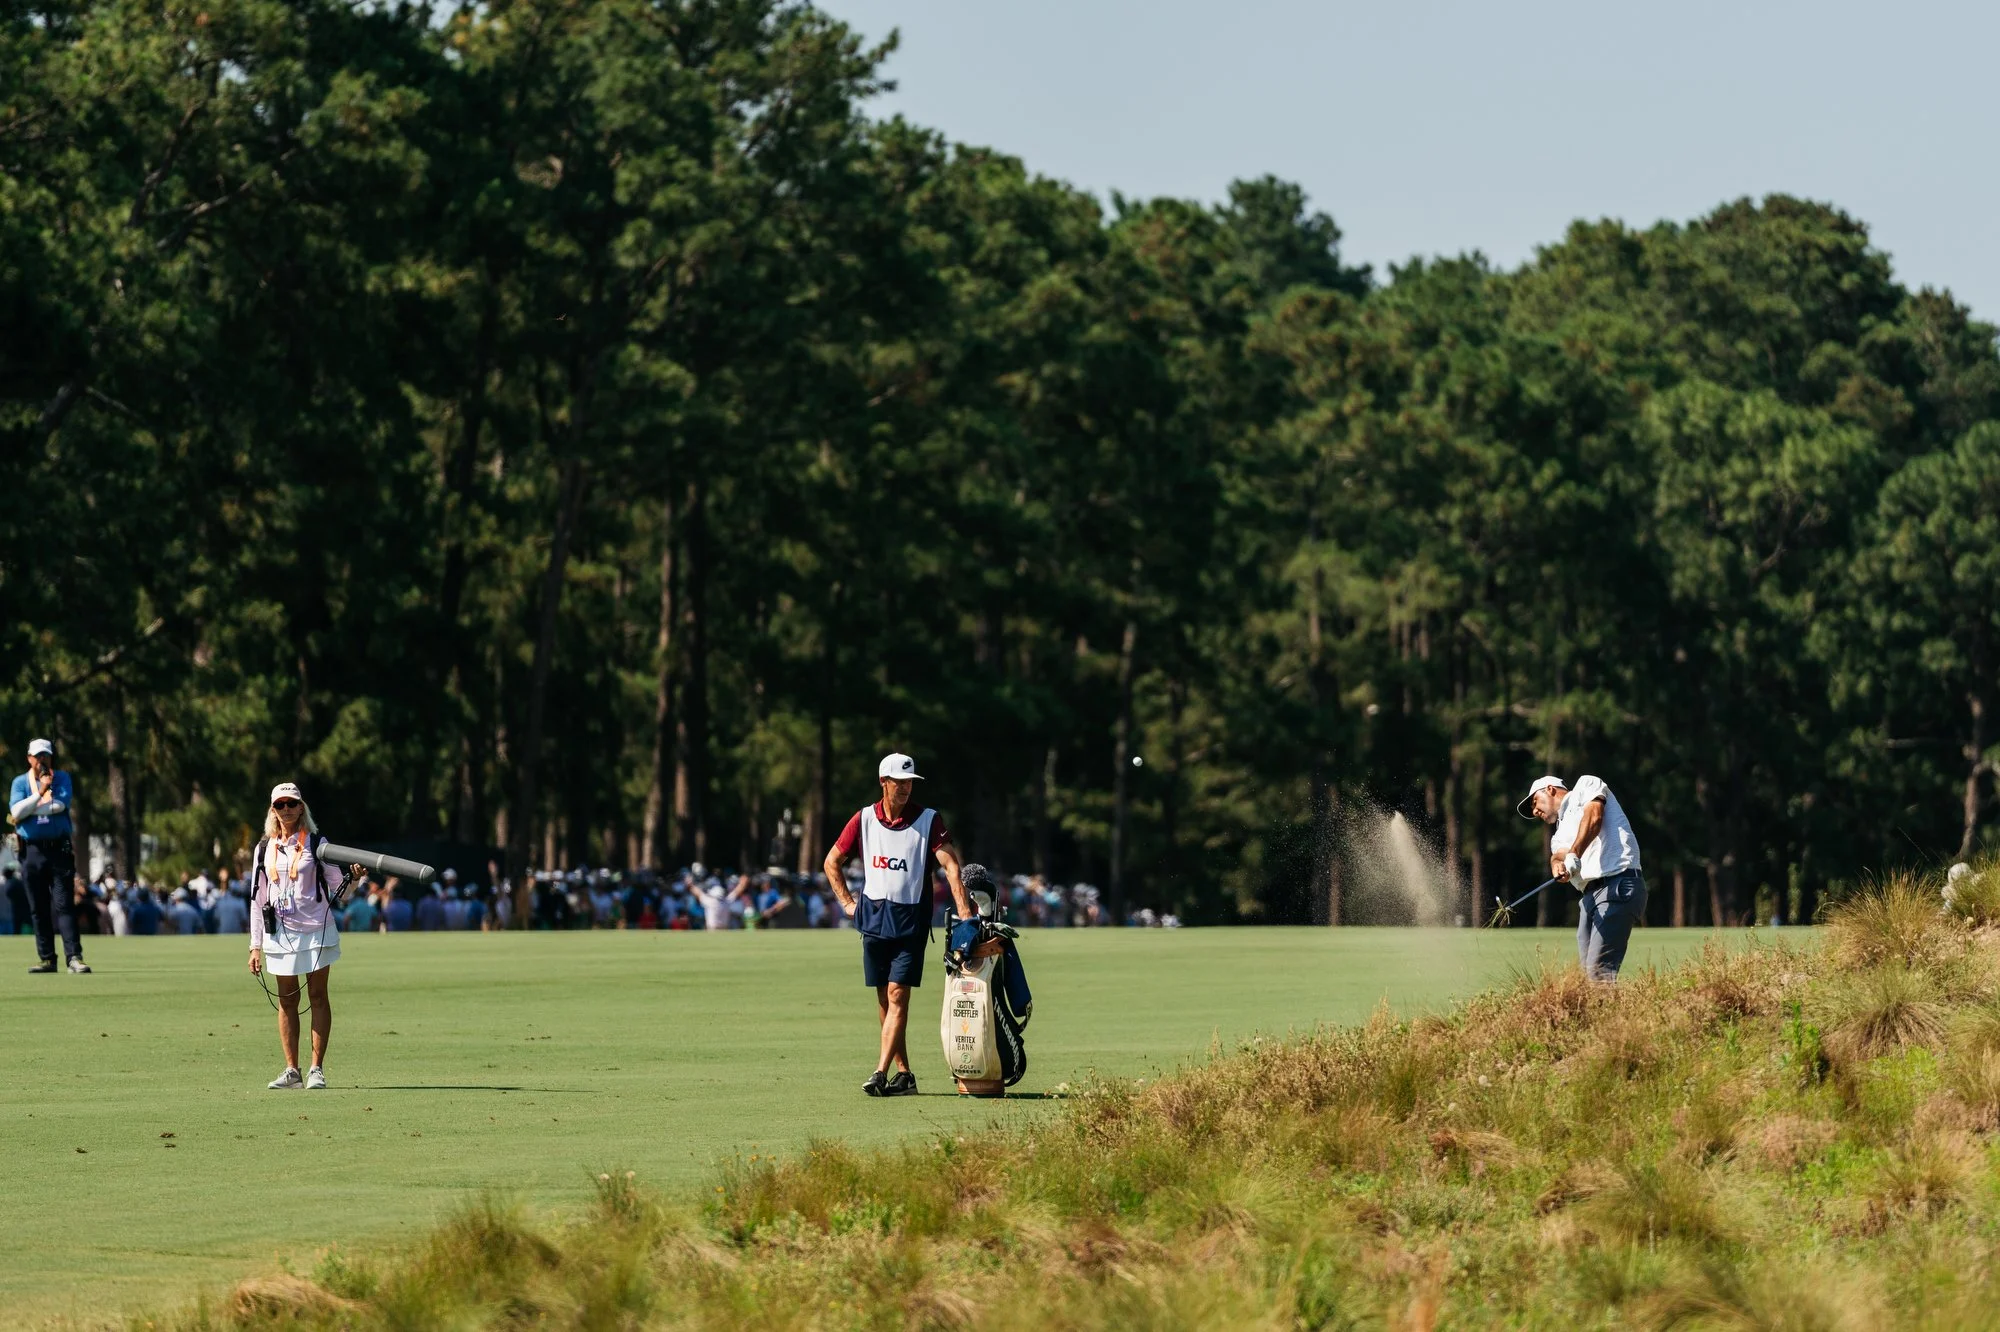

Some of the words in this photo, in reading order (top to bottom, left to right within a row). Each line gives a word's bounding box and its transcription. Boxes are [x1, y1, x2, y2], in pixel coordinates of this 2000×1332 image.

[873, 856, 908, 872] USGA
[953, 1009, 979, 1018] SCHEFFLER
[957, 1043, 975, 1051] BANK
